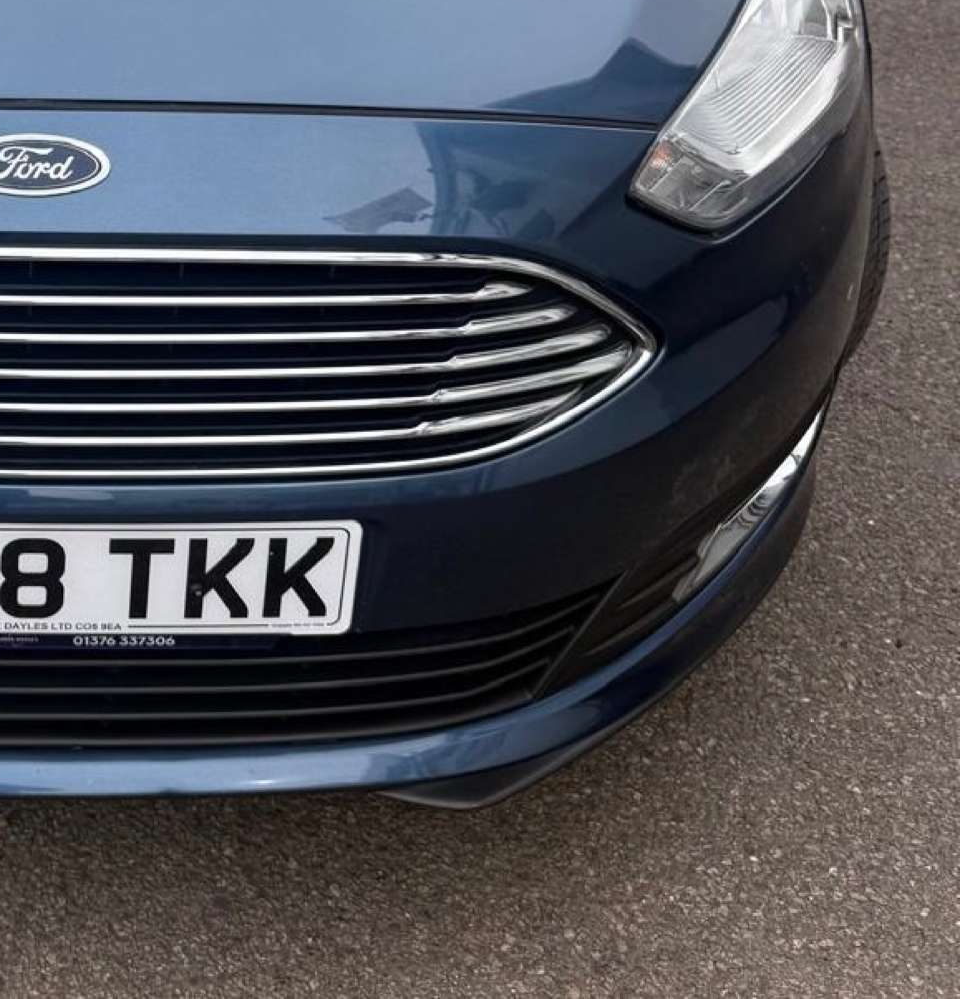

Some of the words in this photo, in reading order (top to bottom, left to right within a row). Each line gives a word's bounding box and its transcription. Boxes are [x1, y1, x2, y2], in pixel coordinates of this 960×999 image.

[109, 534, 335, 621] TKK
[4, 621, 48, 631] DAYLES
[51, 622, 72, 631] LTD
[72, 635, 116, 647] 01376
[118, 635, 176, 647] 337306
